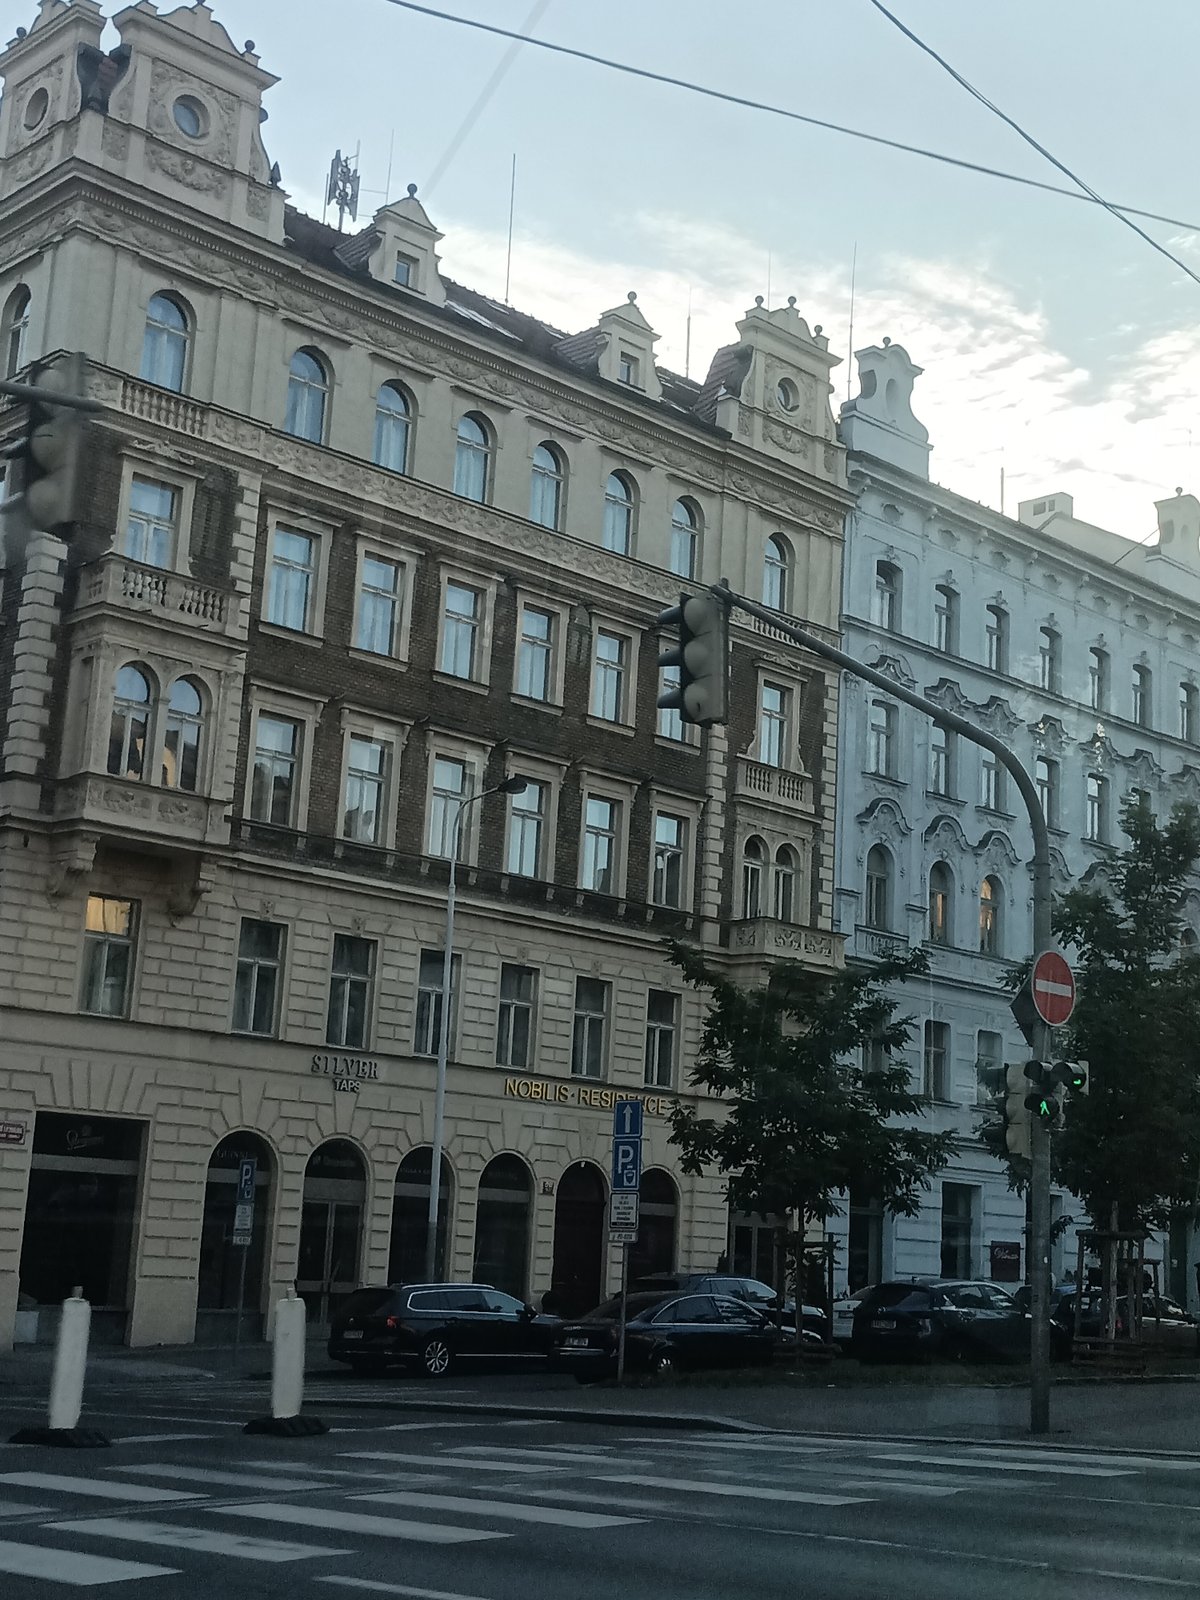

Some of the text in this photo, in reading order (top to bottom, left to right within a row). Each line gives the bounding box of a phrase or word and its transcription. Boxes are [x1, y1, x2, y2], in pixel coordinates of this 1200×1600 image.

[311, 1055, 378, 1079] SILVER
[332, 1079, 361, 1093] TAPS
[504, 1077, 569, 1103] NOBILIS
[618, 1145, 634, 1174] P
[241, 1164, 251, 1188] P
